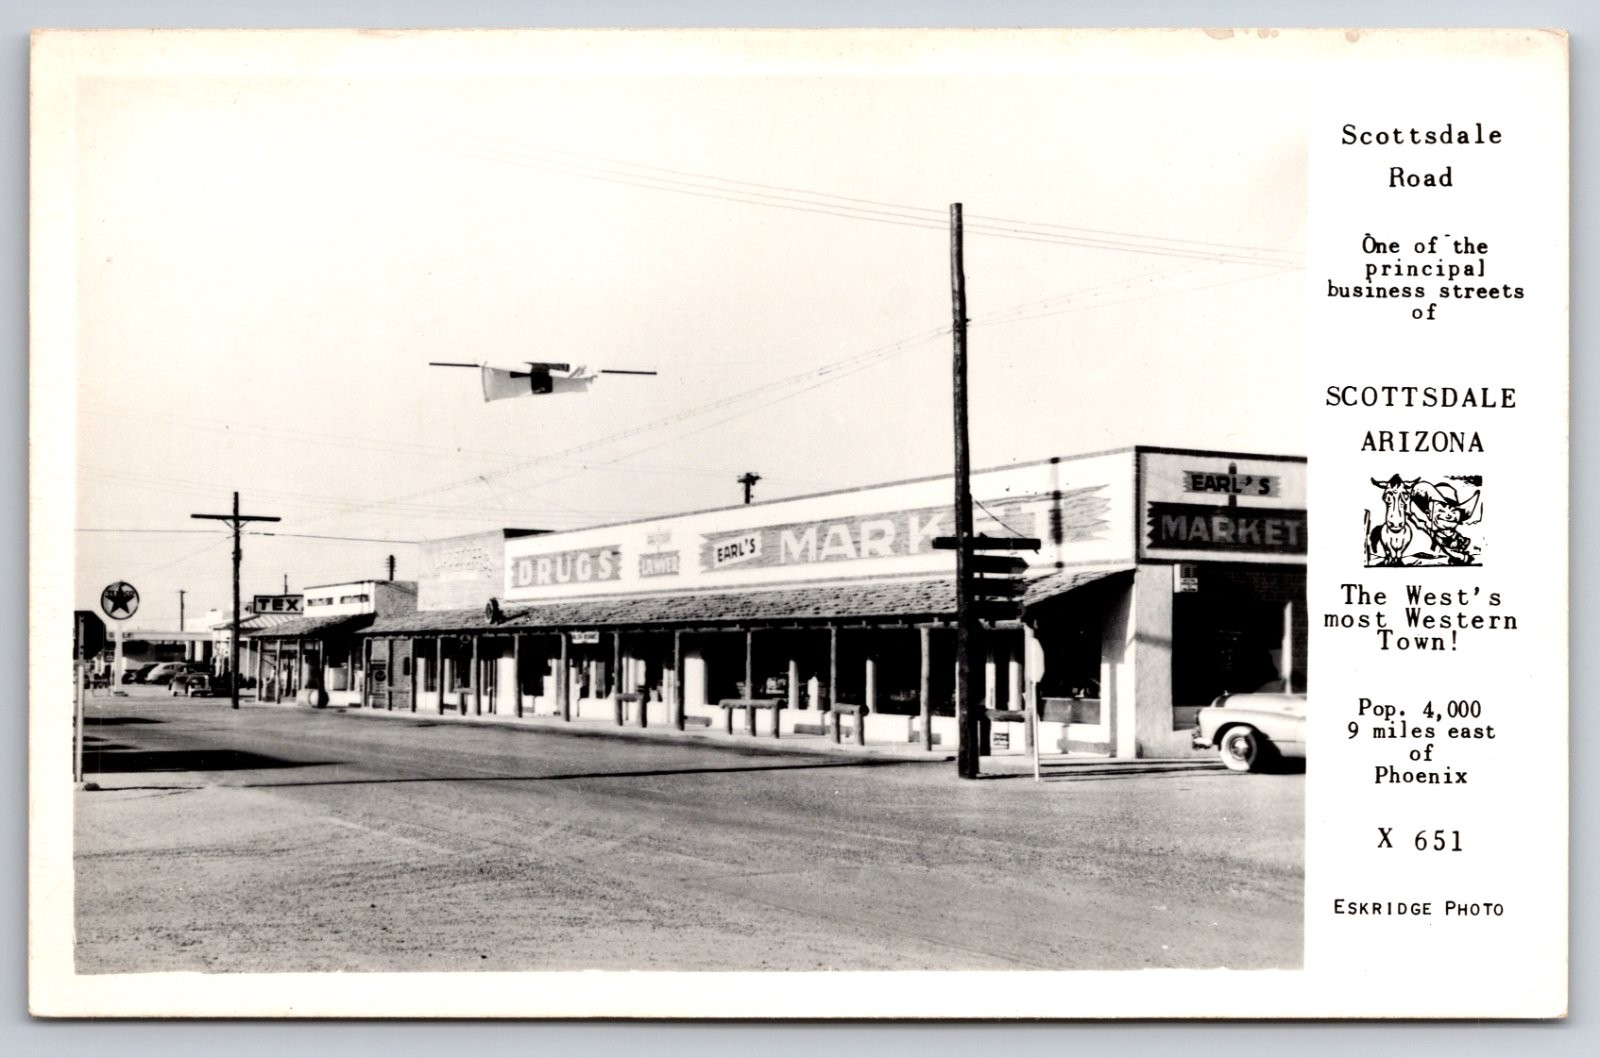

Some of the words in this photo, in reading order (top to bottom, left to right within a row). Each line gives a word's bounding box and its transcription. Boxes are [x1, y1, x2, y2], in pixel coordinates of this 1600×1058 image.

[1191, 474, 1271, 495] EARL'S
[778, 502, 1062, 564] MARKT
[1161, 513, 1301, 546] MARKET
[716, 536, 756, 564] EARL'S
[518, 549, 613, 586] DRUGS
